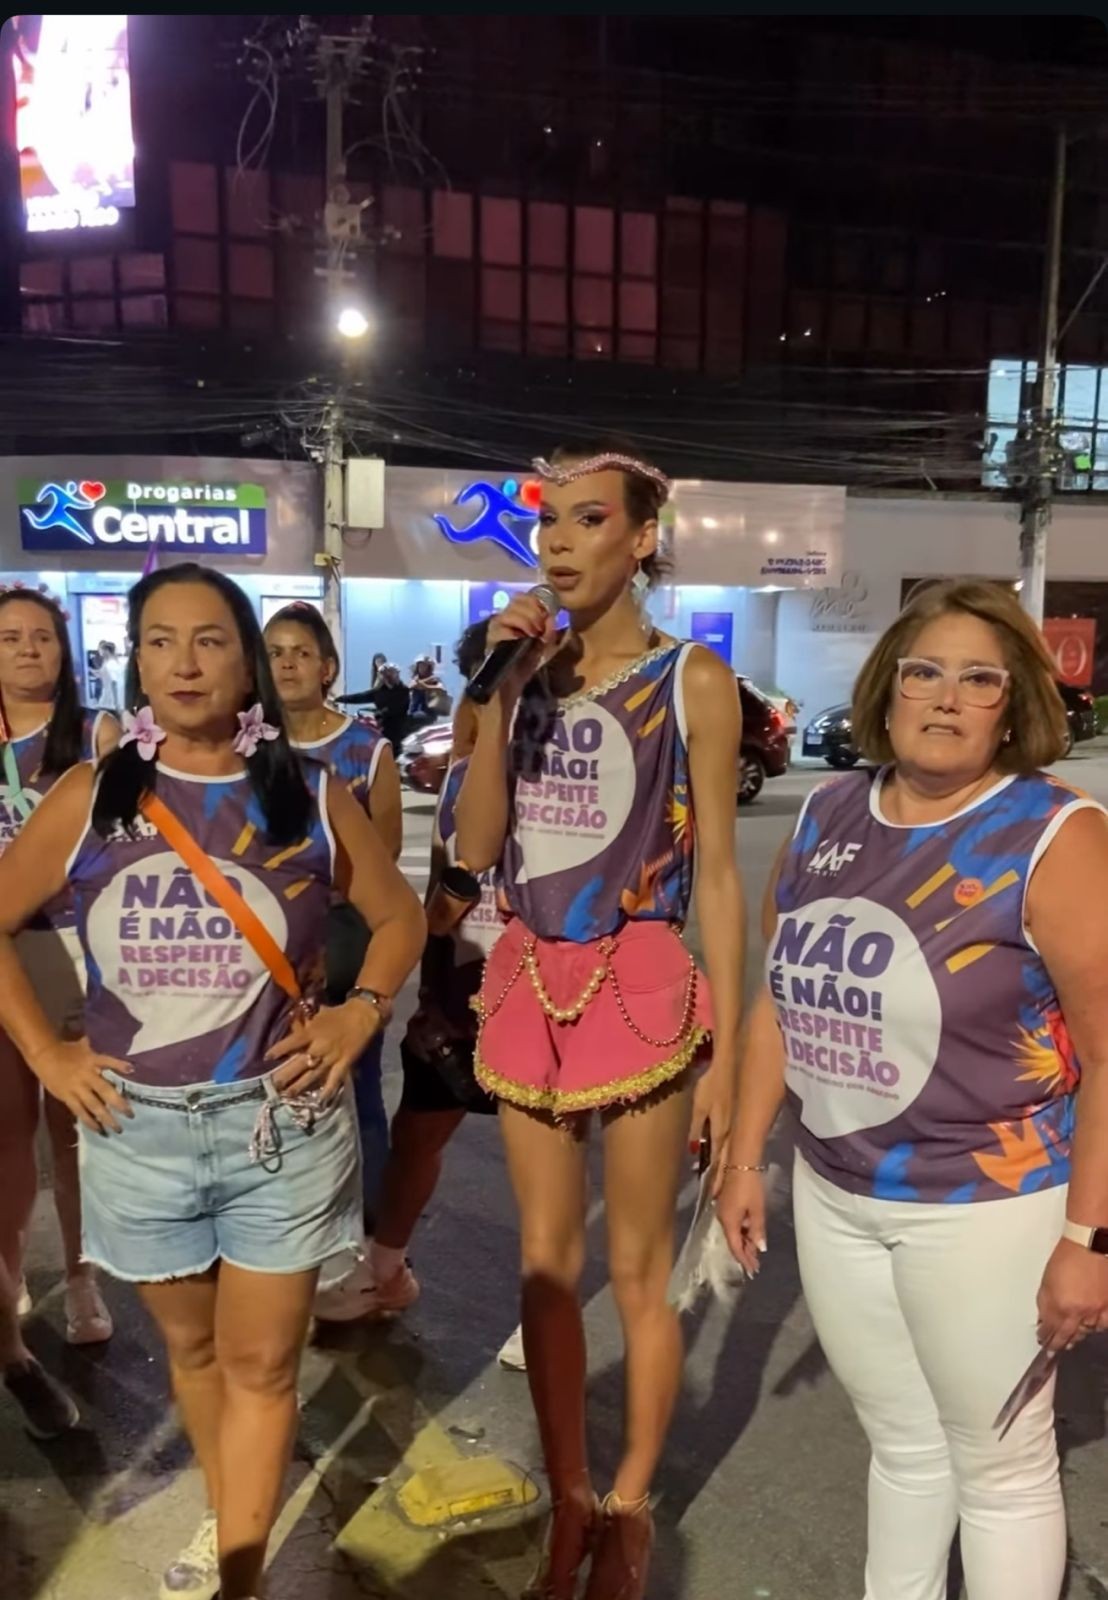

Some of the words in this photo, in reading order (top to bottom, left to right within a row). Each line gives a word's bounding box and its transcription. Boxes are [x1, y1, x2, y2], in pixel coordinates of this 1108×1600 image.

[127, 482, 237, 502] Drogarias
[92, 506, 250, 545] Central
[547, 709, 603, 754] ÃO
[517, 781, 599, 804] ESPEITE
[119, 911, 140, 940] É
[120, 944, 243, 965] RESPEITE
[772, 914, 895, 979] NÃO
[117, 968, 131, 986] A
[137, 963, 253, 989] DECISÃO
[769, 966, 785, 1001] É
[790, 974, 884, 1021] NÃO!
[777, 1004, 884, 1053] RESPEITE
[790, 1035, 901, 1087] DECISÃO
